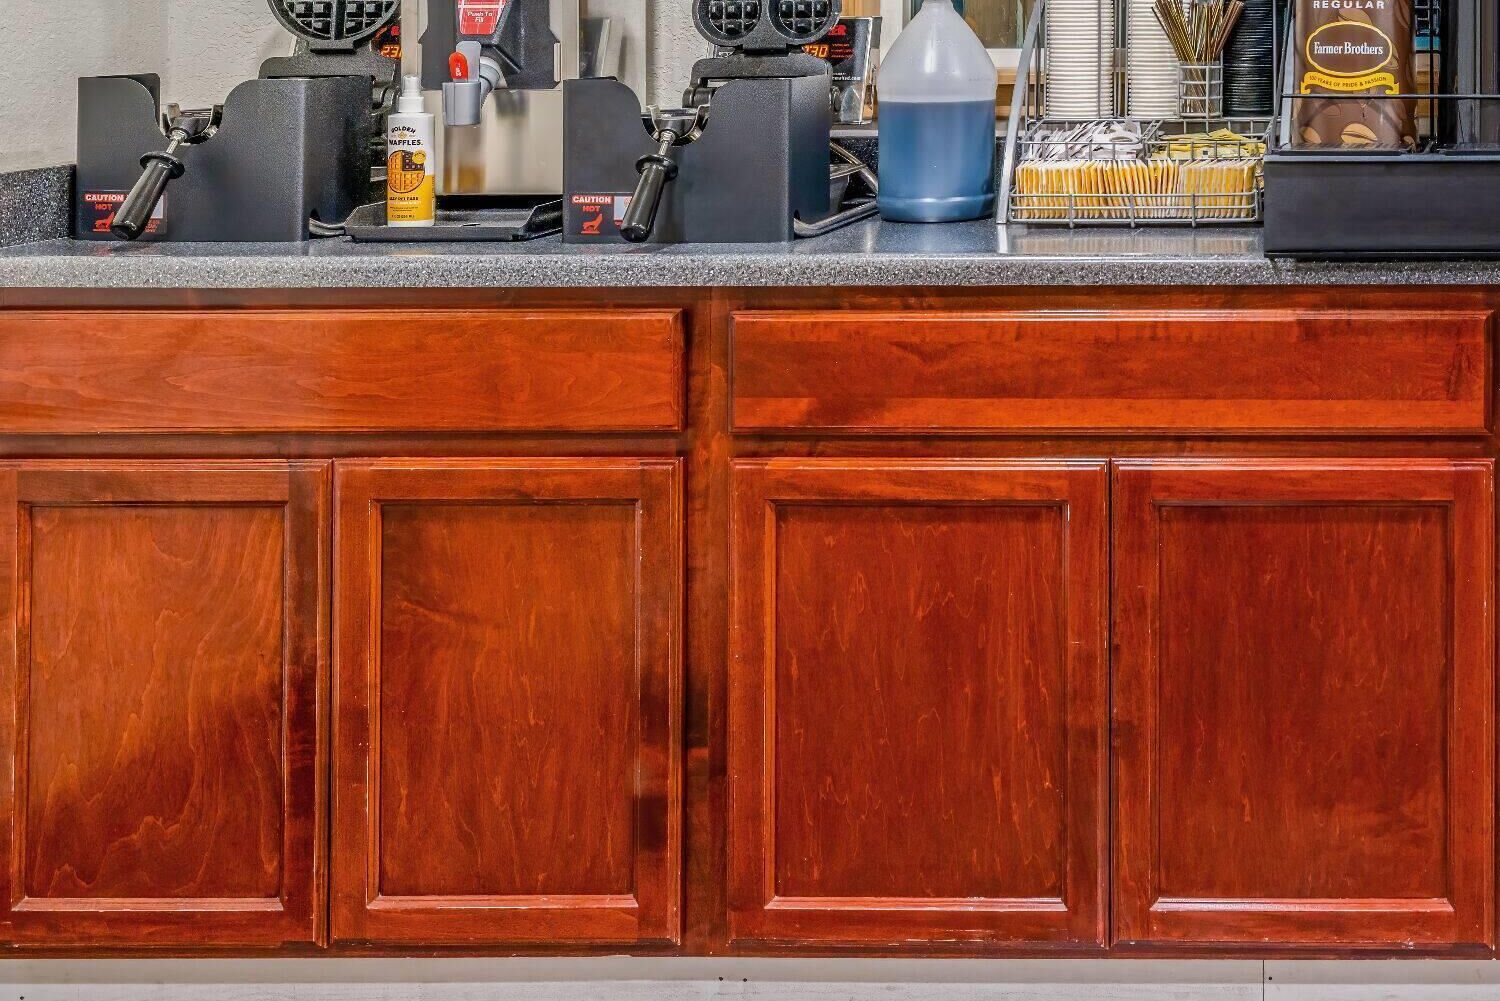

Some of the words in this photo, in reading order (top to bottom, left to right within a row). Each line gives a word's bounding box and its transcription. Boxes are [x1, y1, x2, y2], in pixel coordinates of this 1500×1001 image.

[1313, 0, 1385, 9] REGULAR
[1314, 41, 1343, 54] Farmer
[1344, 41, 1384, 55] Brothers
[1364, 76, 1387, 85] PASSION
